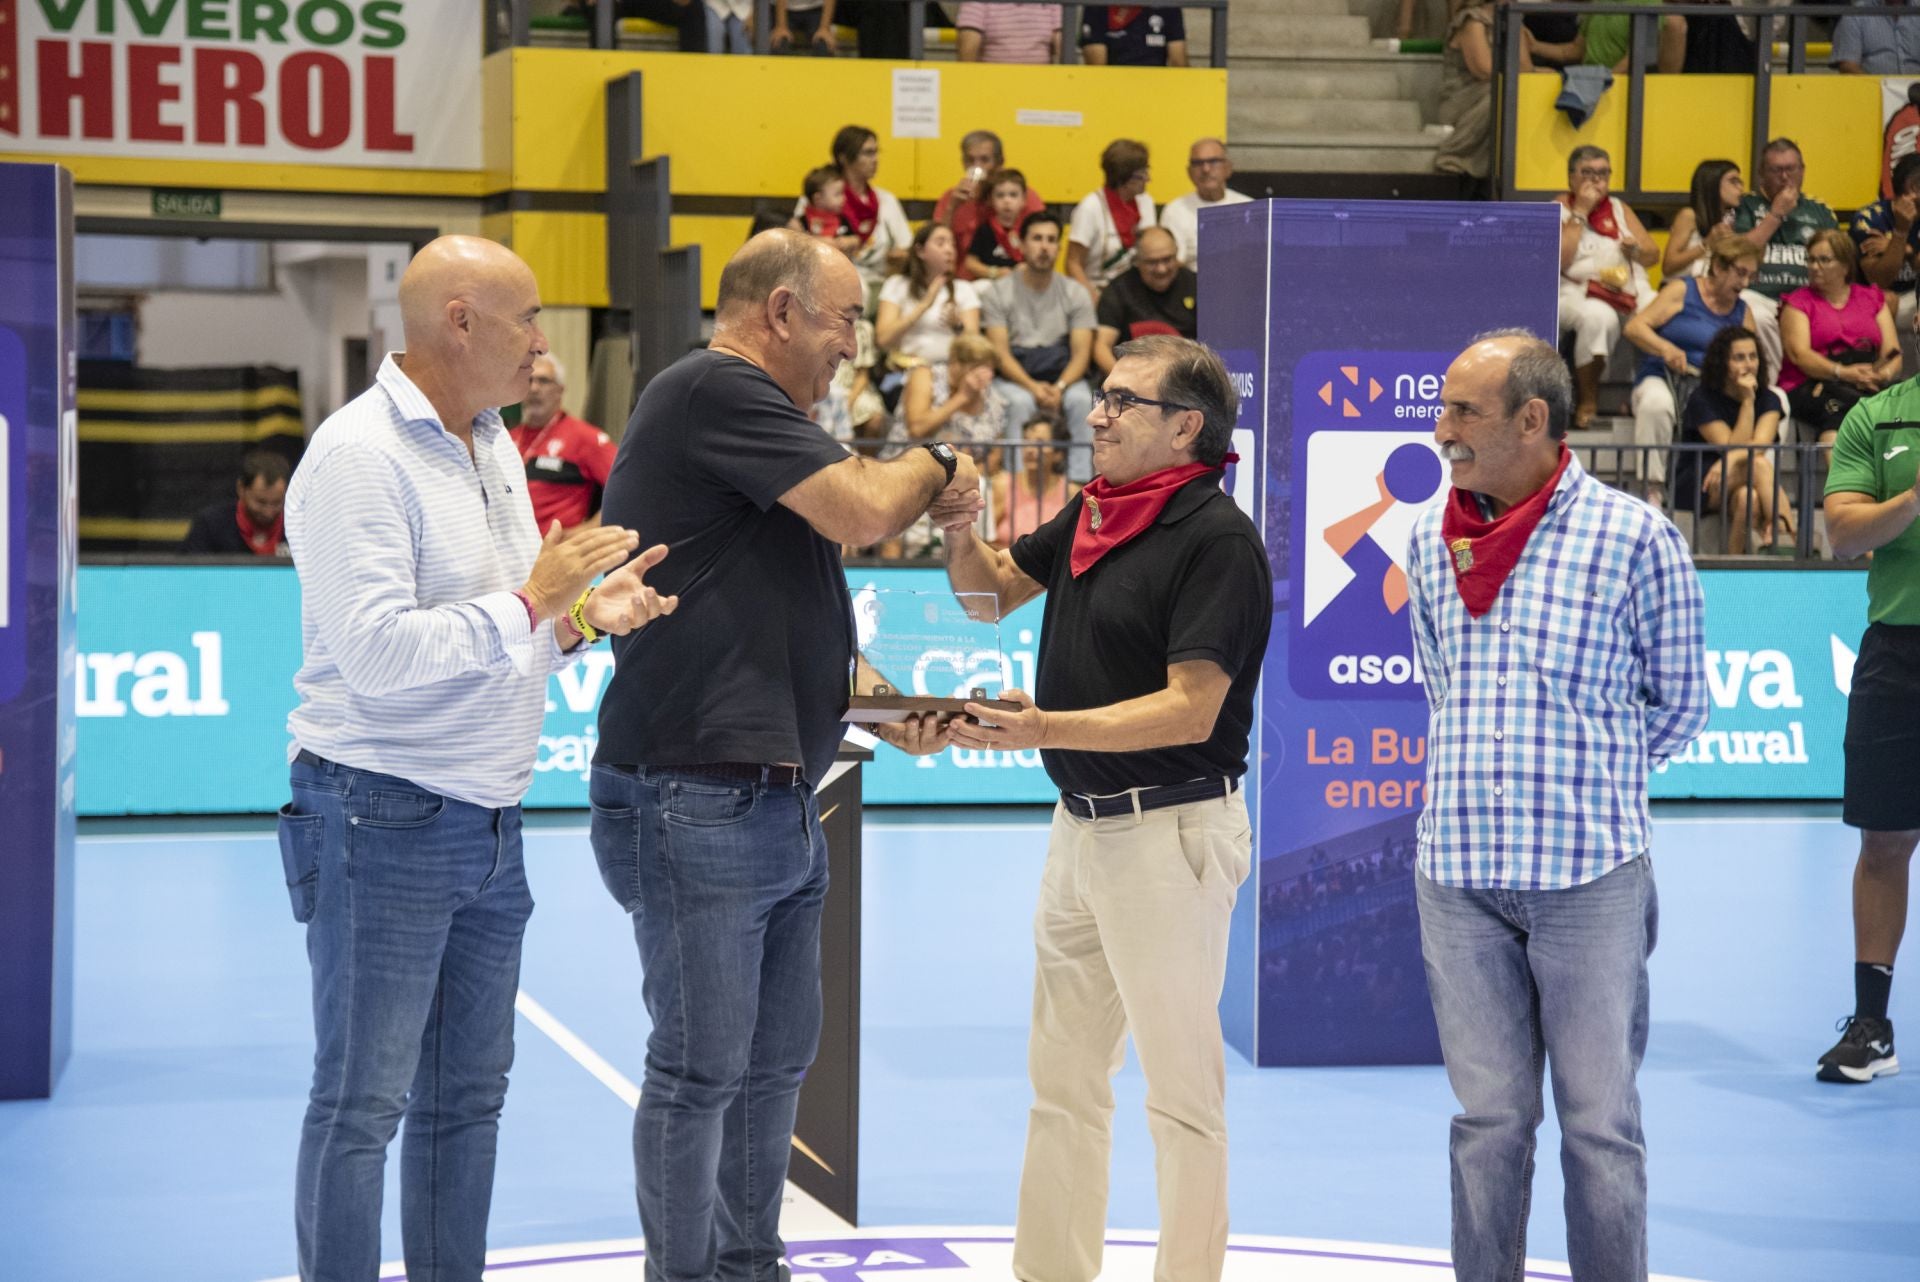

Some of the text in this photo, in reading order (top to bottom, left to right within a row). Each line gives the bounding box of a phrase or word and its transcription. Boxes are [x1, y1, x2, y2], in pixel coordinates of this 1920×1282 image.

[35, 0, 407, 48] VIVEROS
[37, 38, 415, 153] HEROL
[157, 193, 214, 213] SALIDA
[1395, 374, 1446, 400] ne
[1307, 728, 1426, 765] La Bu
[1324, 779, 1428, 809] ener
[778, 1250, 927, 1269] GA
